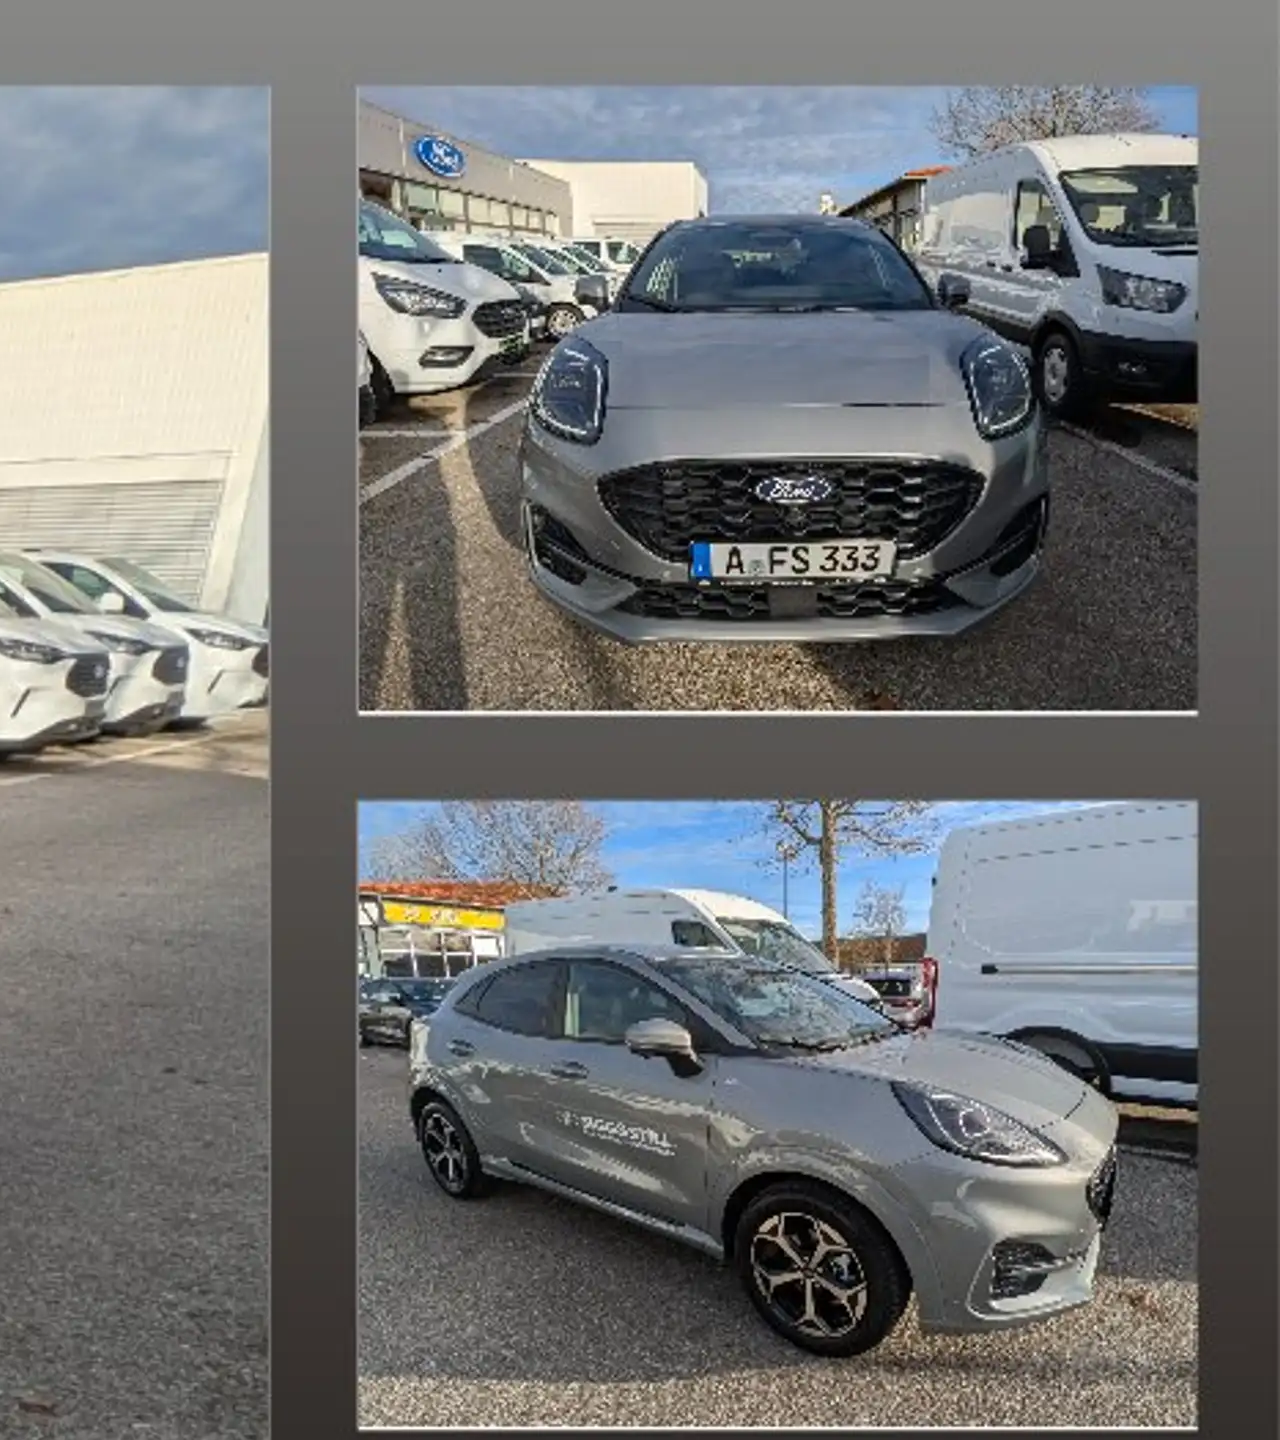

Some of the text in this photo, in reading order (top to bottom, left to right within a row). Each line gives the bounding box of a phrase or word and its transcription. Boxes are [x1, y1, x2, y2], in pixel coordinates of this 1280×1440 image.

[725, 544, 881, 574] A FS 333
